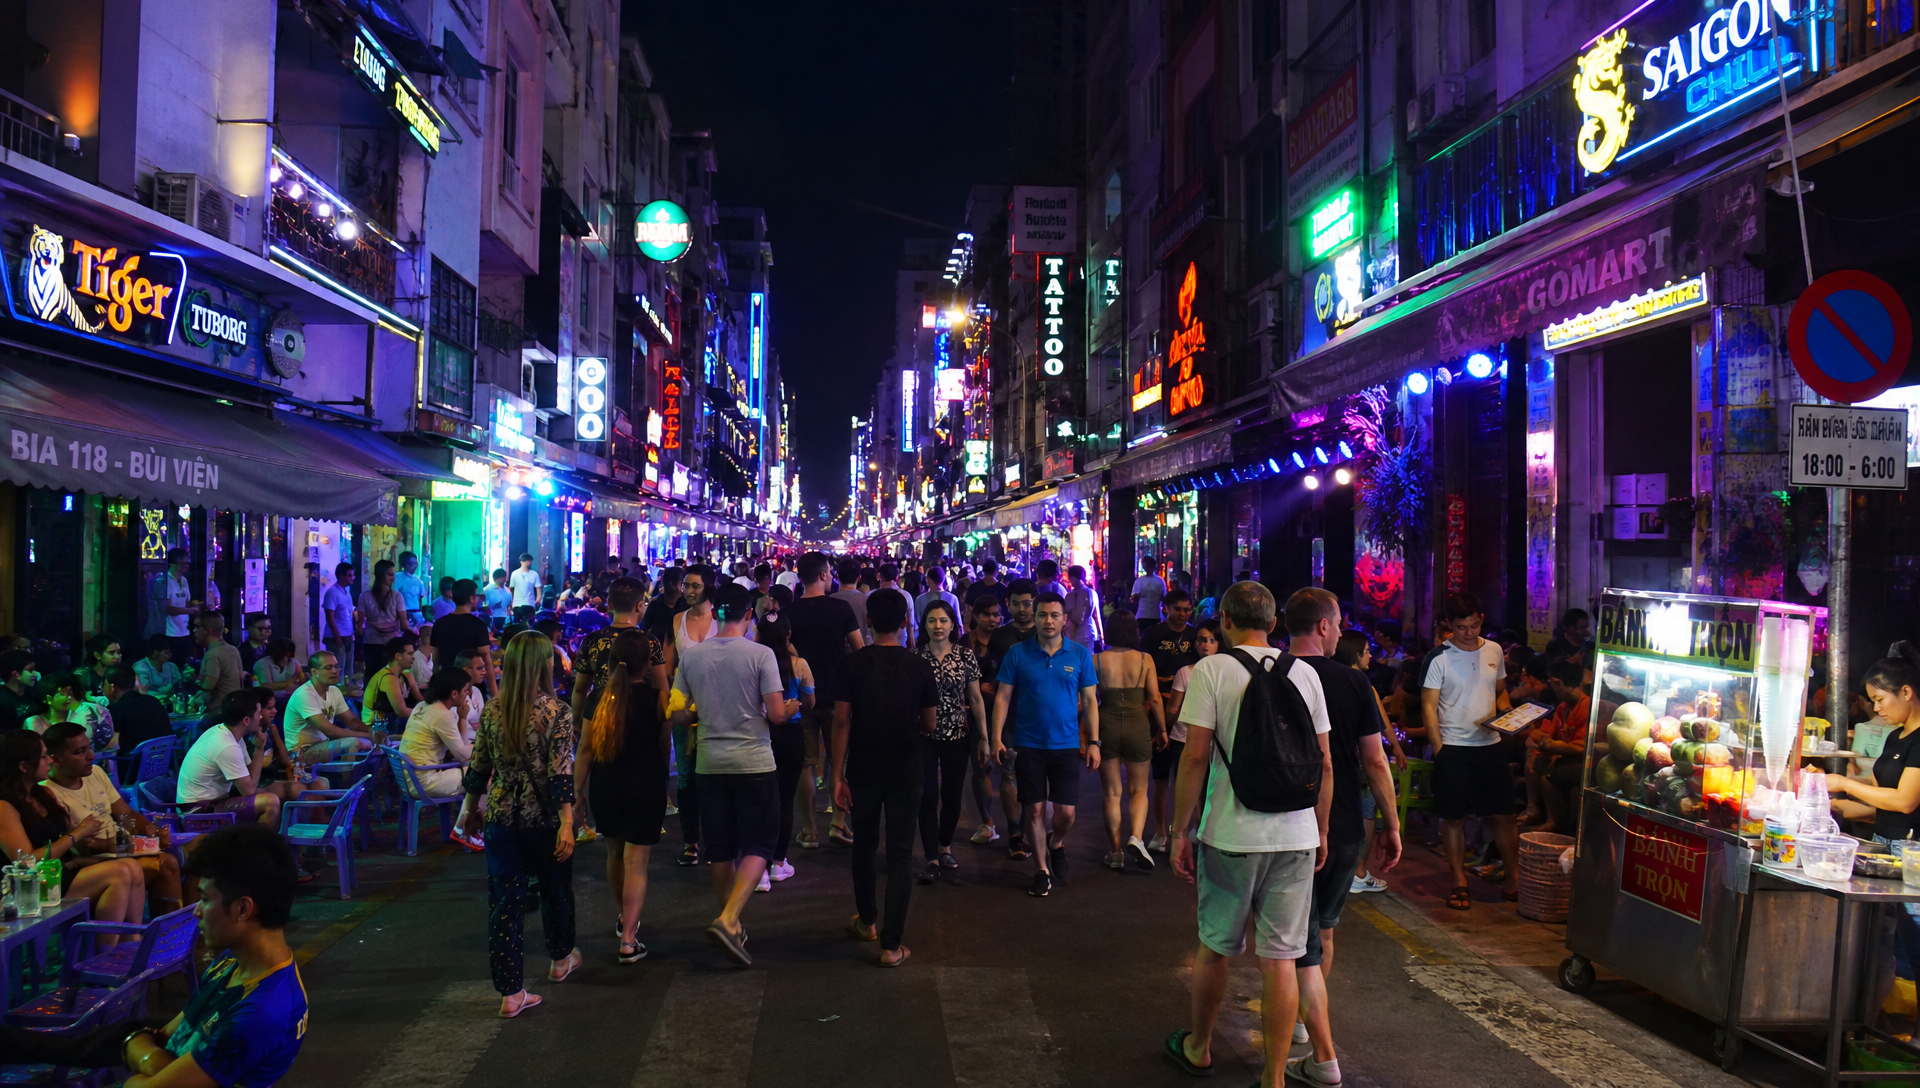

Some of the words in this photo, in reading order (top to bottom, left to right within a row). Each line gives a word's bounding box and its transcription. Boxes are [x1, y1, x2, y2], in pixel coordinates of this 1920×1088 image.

[1643, 0, 1792, 100] SAIGON
[1686, 35, 1798, 113] CHILL
[72, 239, 173, 332] Tiger
[1527, 226, 1672, 315] GOMART
[191, 304, 247, 345] TUBORG
[1044, 258, 1064, 376] TATTOO
[11, 429, 59, 466] BIA
[69, 441, 108, 473] 118
[114, 461, 123, 469] -
[129, 447, 167, 483] BÙI
[172, 455, 219, 494] VIỆN
[1803, 453, 1843, 477] 18:00
[1861, 455, 1896, 479] 6:00
